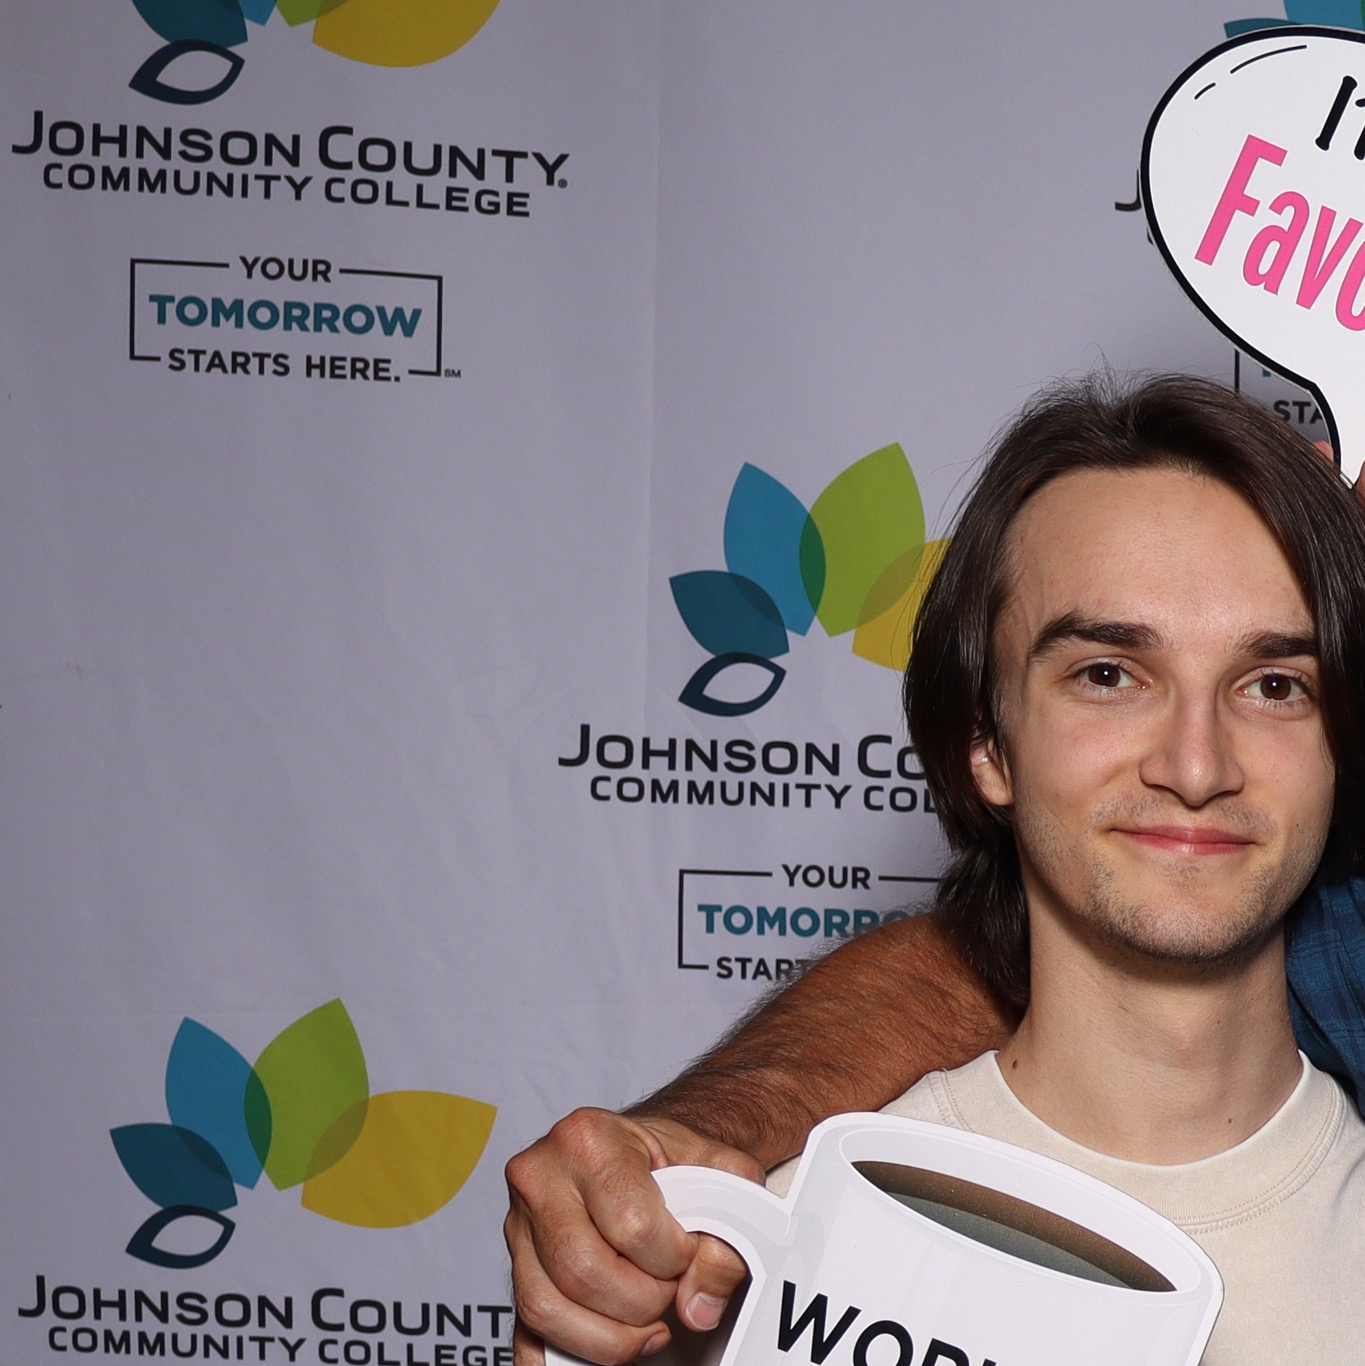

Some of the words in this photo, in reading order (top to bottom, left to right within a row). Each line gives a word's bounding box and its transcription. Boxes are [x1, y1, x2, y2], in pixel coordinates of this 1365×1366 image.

[12, 110, 300, 168] JOHNSON
[43, 163, 313, 200] COMMUNITY
[325, 177, 530, 217] COLLEGE
[239, 256, 332, 283] YOUR
[149, 294, 422, 338] TOMORROW
[168, 348, 291, 378] STARTS
[305, 355, 400, 382] HERE.
[558, 723, 840, 778] JOHNSON
[590, 776, 852, 811] COMMUNITY
[781, 864, 871, 890] YOUR
[18, 1275, 294, 1330] JOHNSON
[311, 1287, 513, 1339] COUNT
[48, 1326, 306, 1362] COMMUNITY
